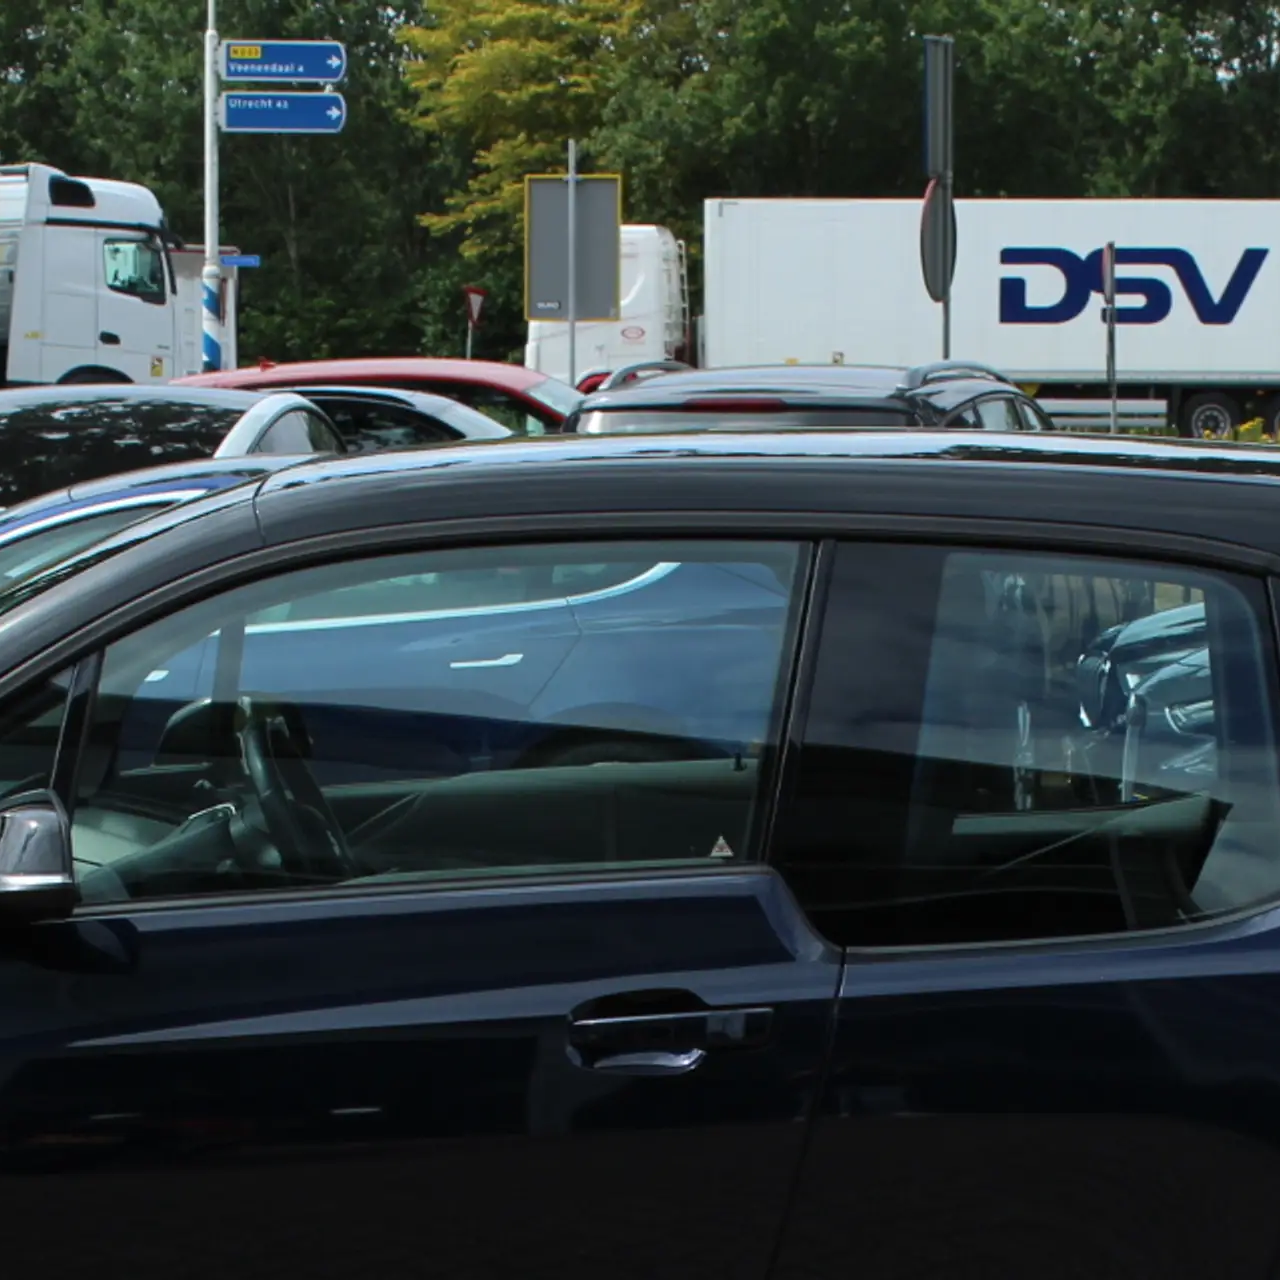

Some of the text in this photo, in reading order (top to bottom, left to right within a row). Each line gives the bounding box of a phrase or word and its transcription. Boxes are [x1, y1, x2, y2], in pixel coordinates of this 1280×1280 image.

[228, 62, 295, 73] Veenendaal
[228, 98, 273, 109] Utrecht
[999, 247, 1270, 325] DSV
